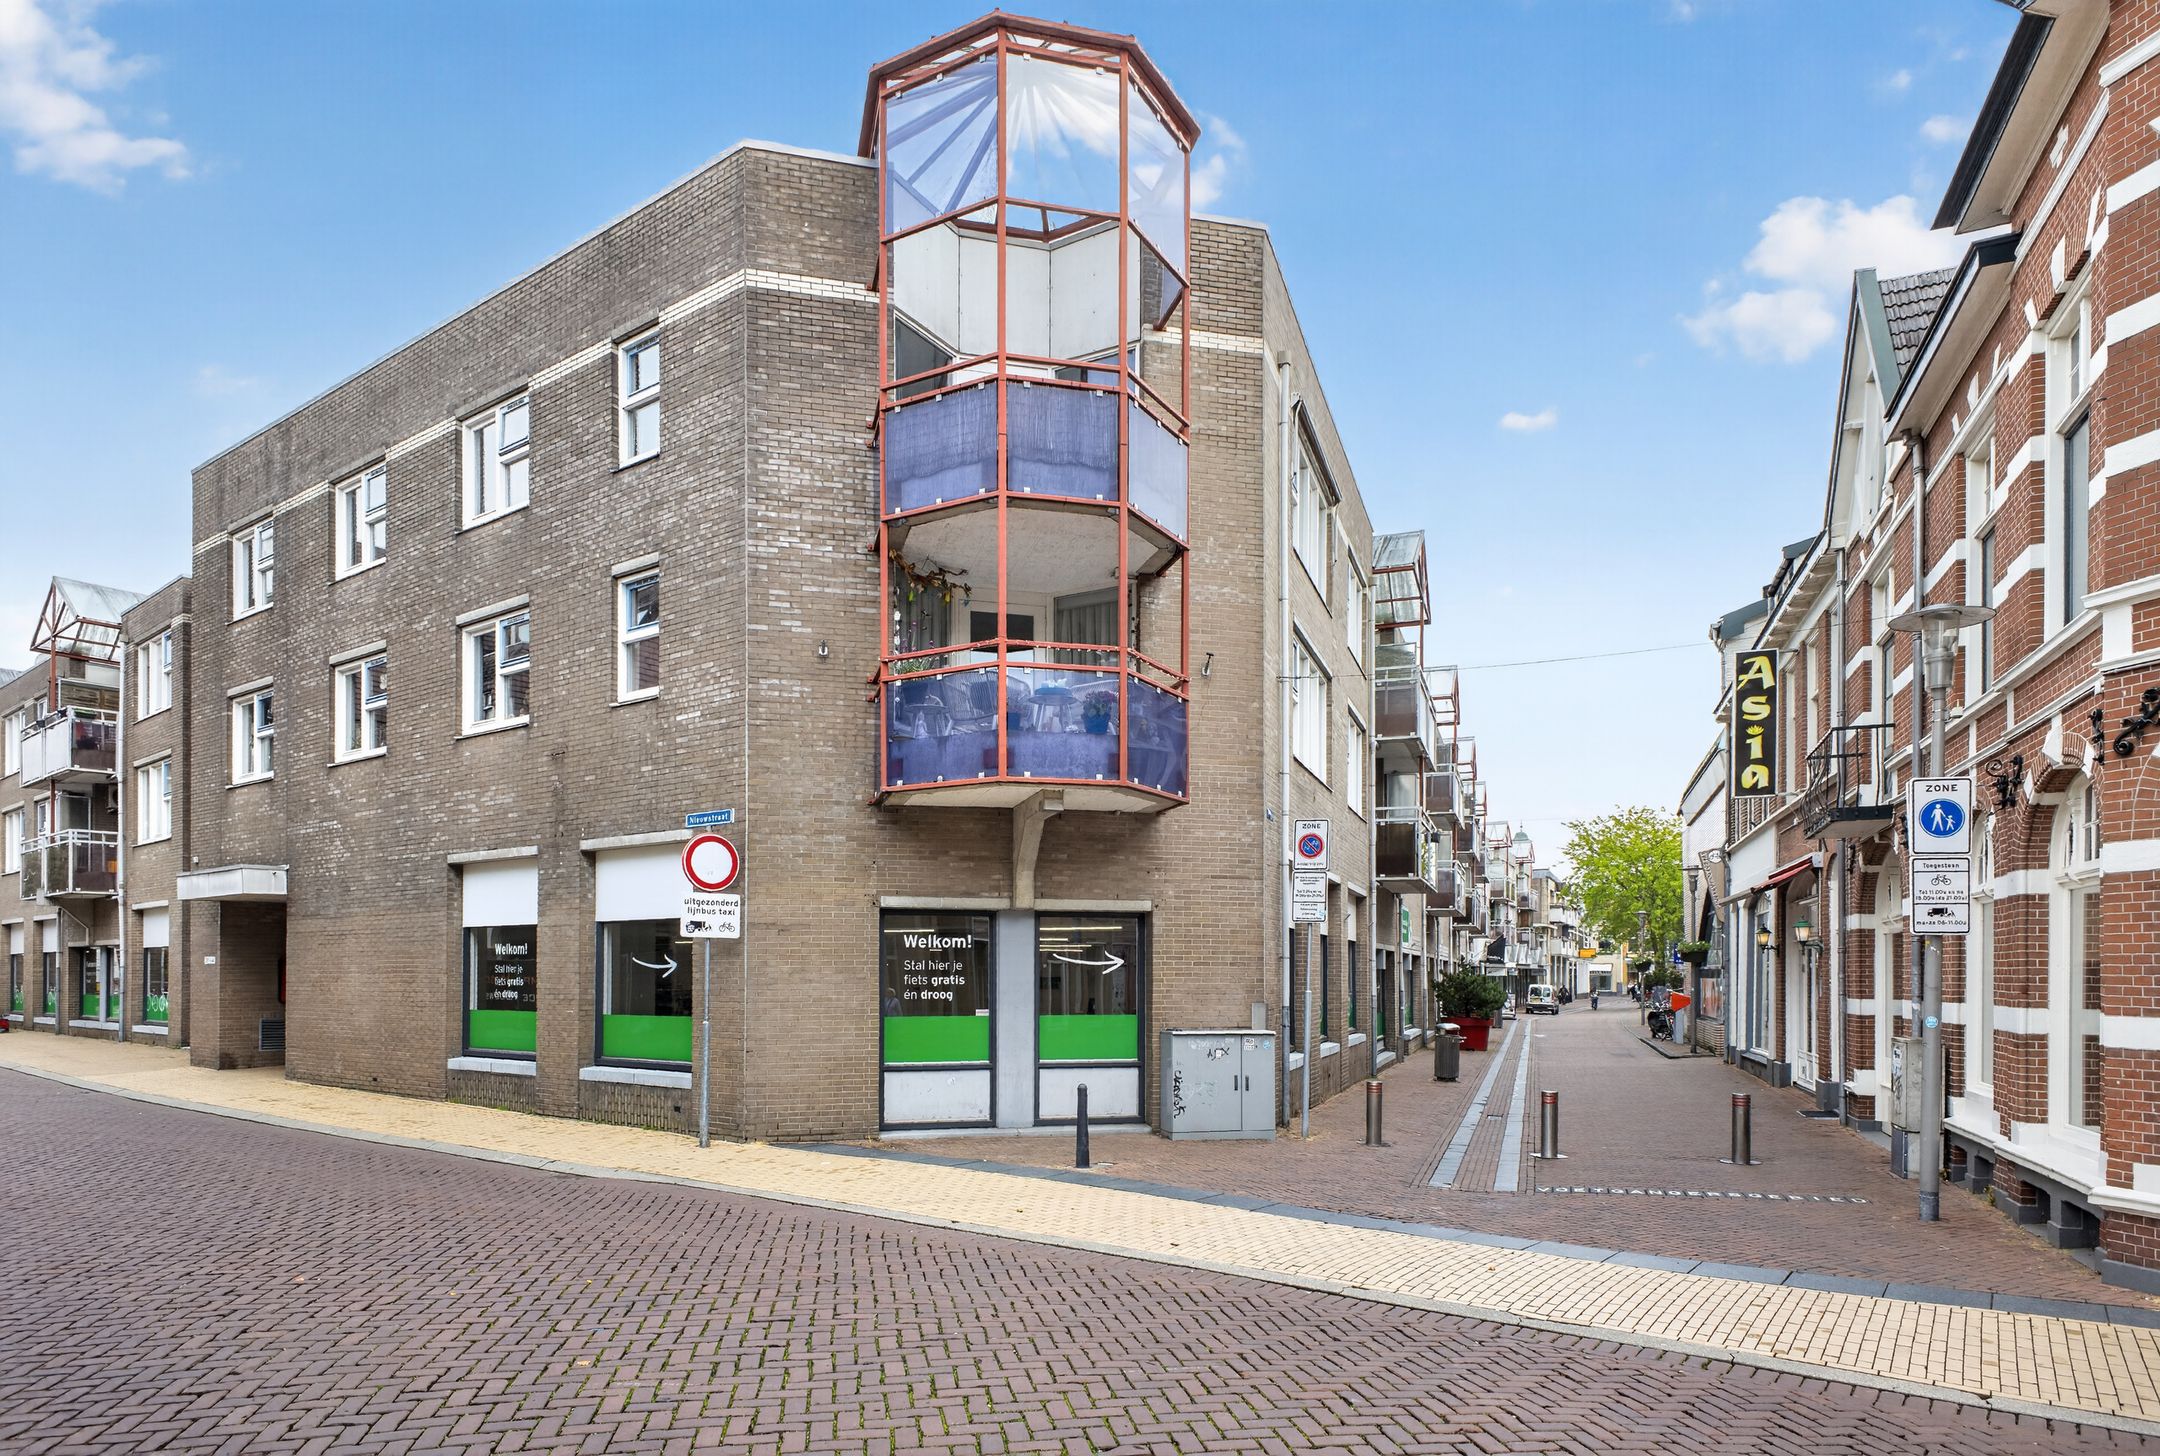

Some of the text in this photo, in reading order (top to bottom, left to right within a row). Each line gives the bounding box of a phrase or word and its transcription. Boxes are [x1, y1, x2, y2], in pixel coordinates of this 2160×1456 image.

[1737, 655, 1775, 790] Asia
[1926, 784, 1958, 793] ZONE
[684, 898, 739, 907] uitgezonderd
[687, 907, 736, 916] lijnbus taxi
[904, 934, 972, 949] Welkom!
[494, 943, 528, 955] Welkom!
[904, 960, 963, 973] Stal hier je
[903, 975, 965, 988] fiets gratis
[903, 990, 953, 1001] én droog
